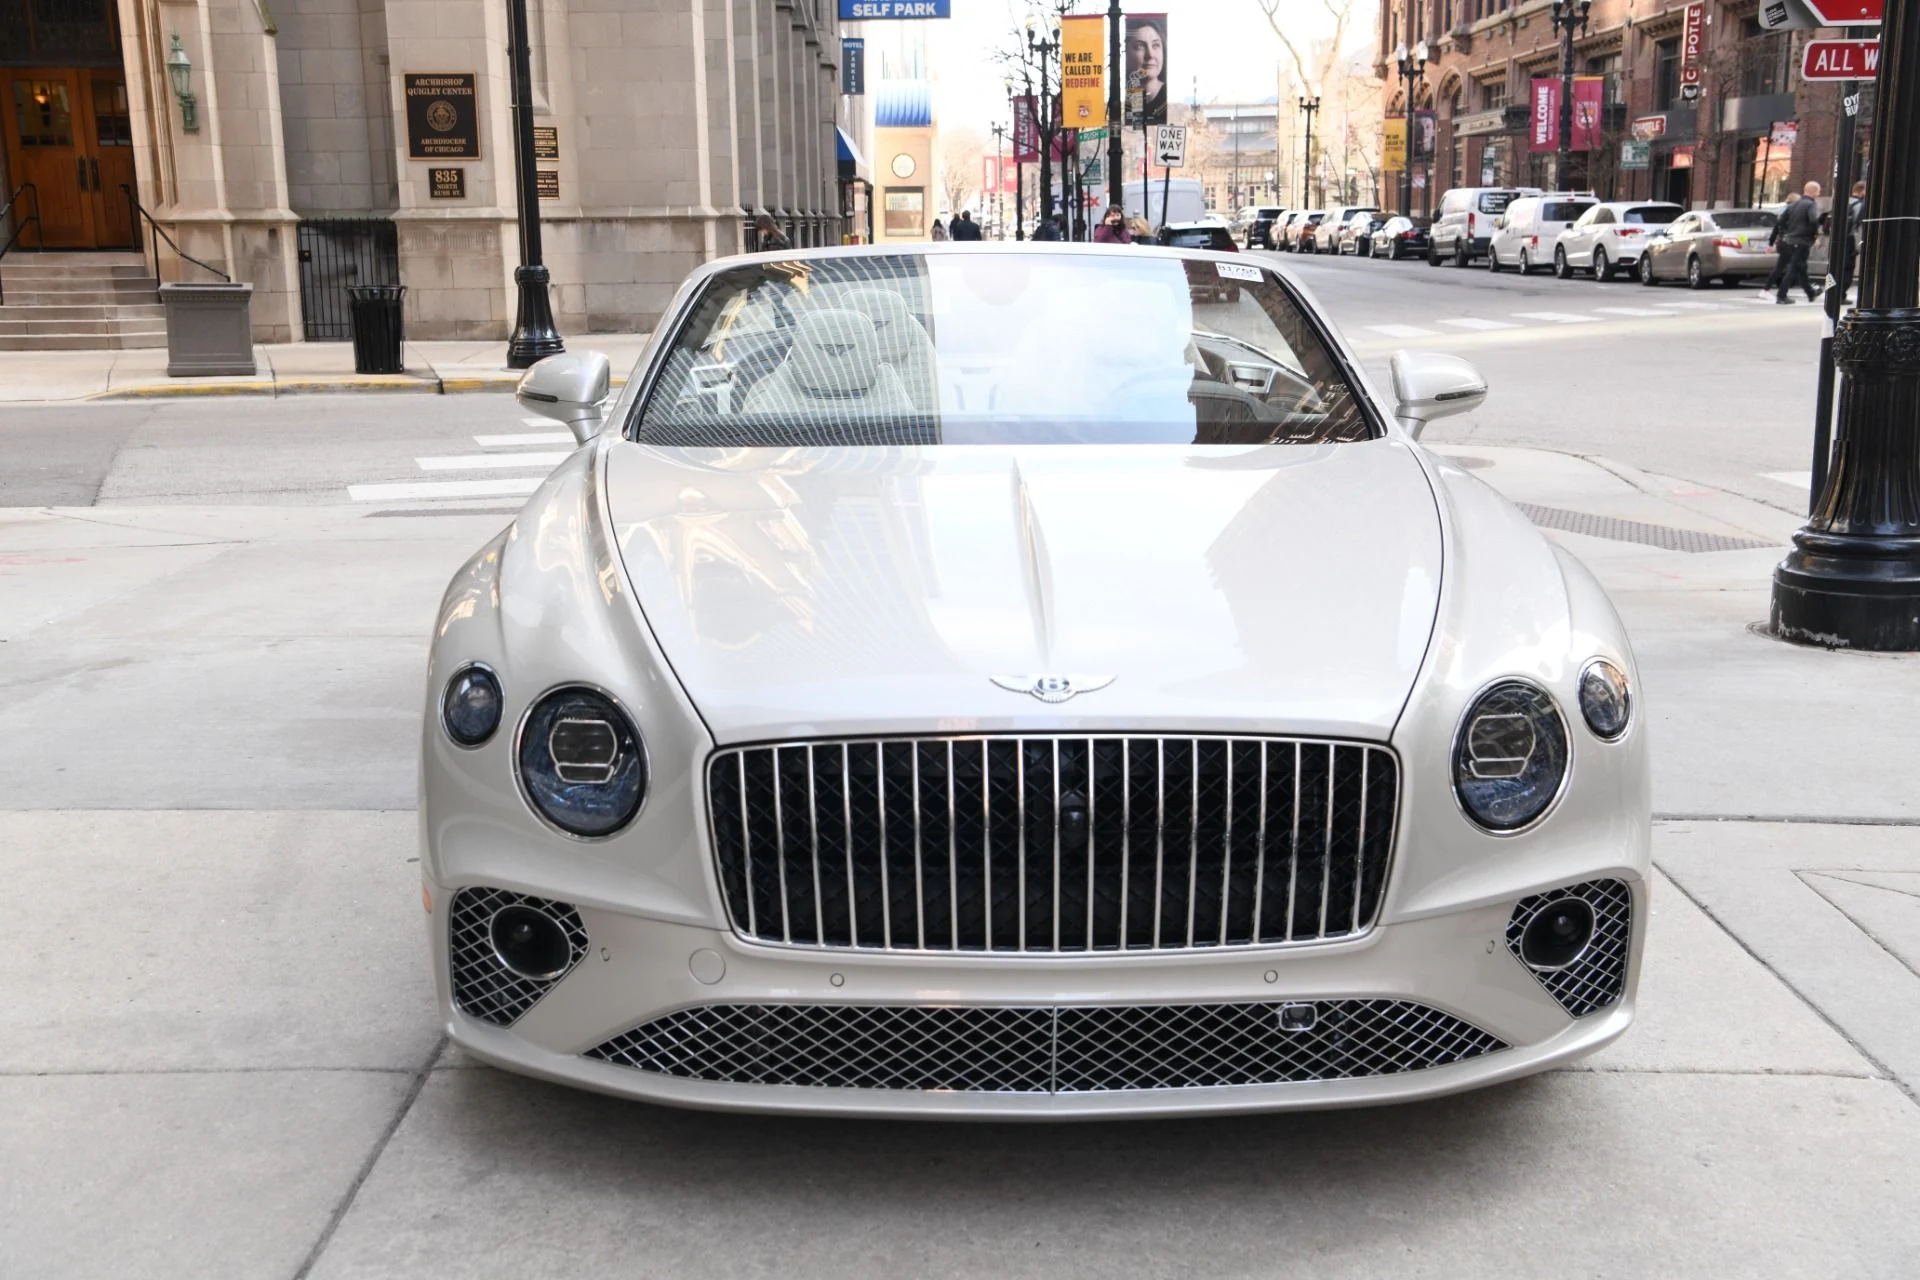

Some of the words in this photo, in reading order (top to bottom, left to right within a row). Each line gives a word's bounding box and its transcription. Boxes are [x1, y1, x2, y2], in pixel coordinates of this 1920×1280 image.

[852, 3, 890, 17] SELF
[894, 2, 937, 16] PARK
[843, 41, 864, 49] HOTEL
[1065, 53, 1076, 63] WE
[1078, 52, 1093, 62] ARE
[1814, 49, 1853, 71] ALL
[1065, 65, 1091, 76] CALLED
[1093, 65, 1102, 75] TO
[415, 78, 465, 87] ARCHBISHOP
[1065, 77, 1100, 88] REDEFINE
[408, 87, 441, 96] QUIGLEY
[442, 87, 473, 96] CENTER
[1536, 86, 1548, 145] WELCOME
[1160, 128, 1182, 140] ONE
[434, 145, 464, 153] CHICAGO
[1159, 140, 1183, 151] WAY
[435, 170, 458, 183] 835
[1051, 193, 1100, 210] FdEx
